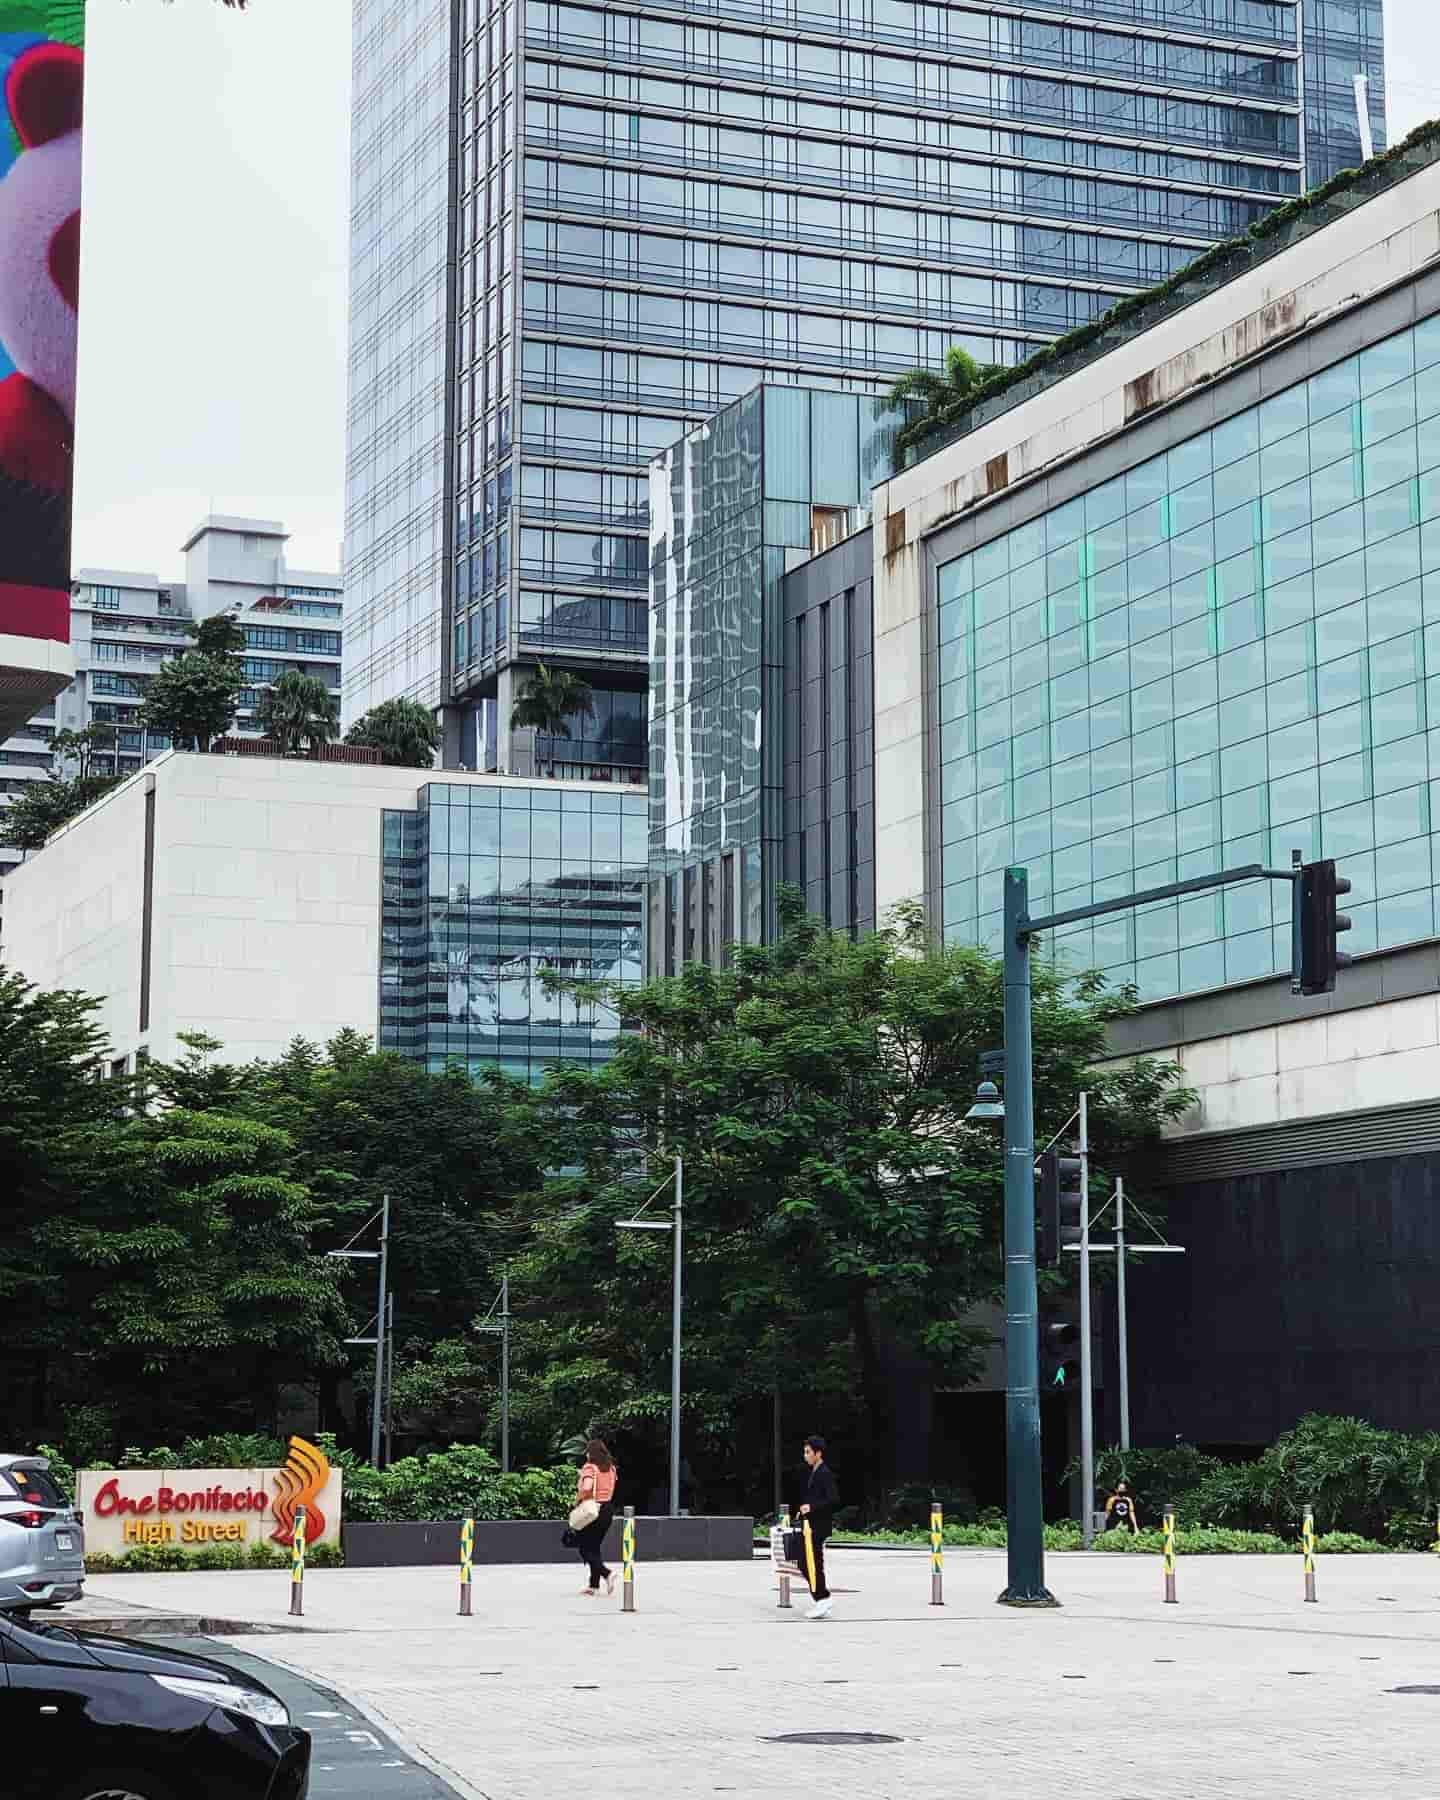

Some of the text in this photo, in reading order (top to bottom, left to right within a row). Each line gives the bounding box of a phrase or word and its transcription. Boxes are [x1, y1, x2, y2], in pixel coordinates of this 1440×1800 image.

[94, 1478, 269, 1516] One Bonifacio
[123, 1519, 247, 1545] High Street
